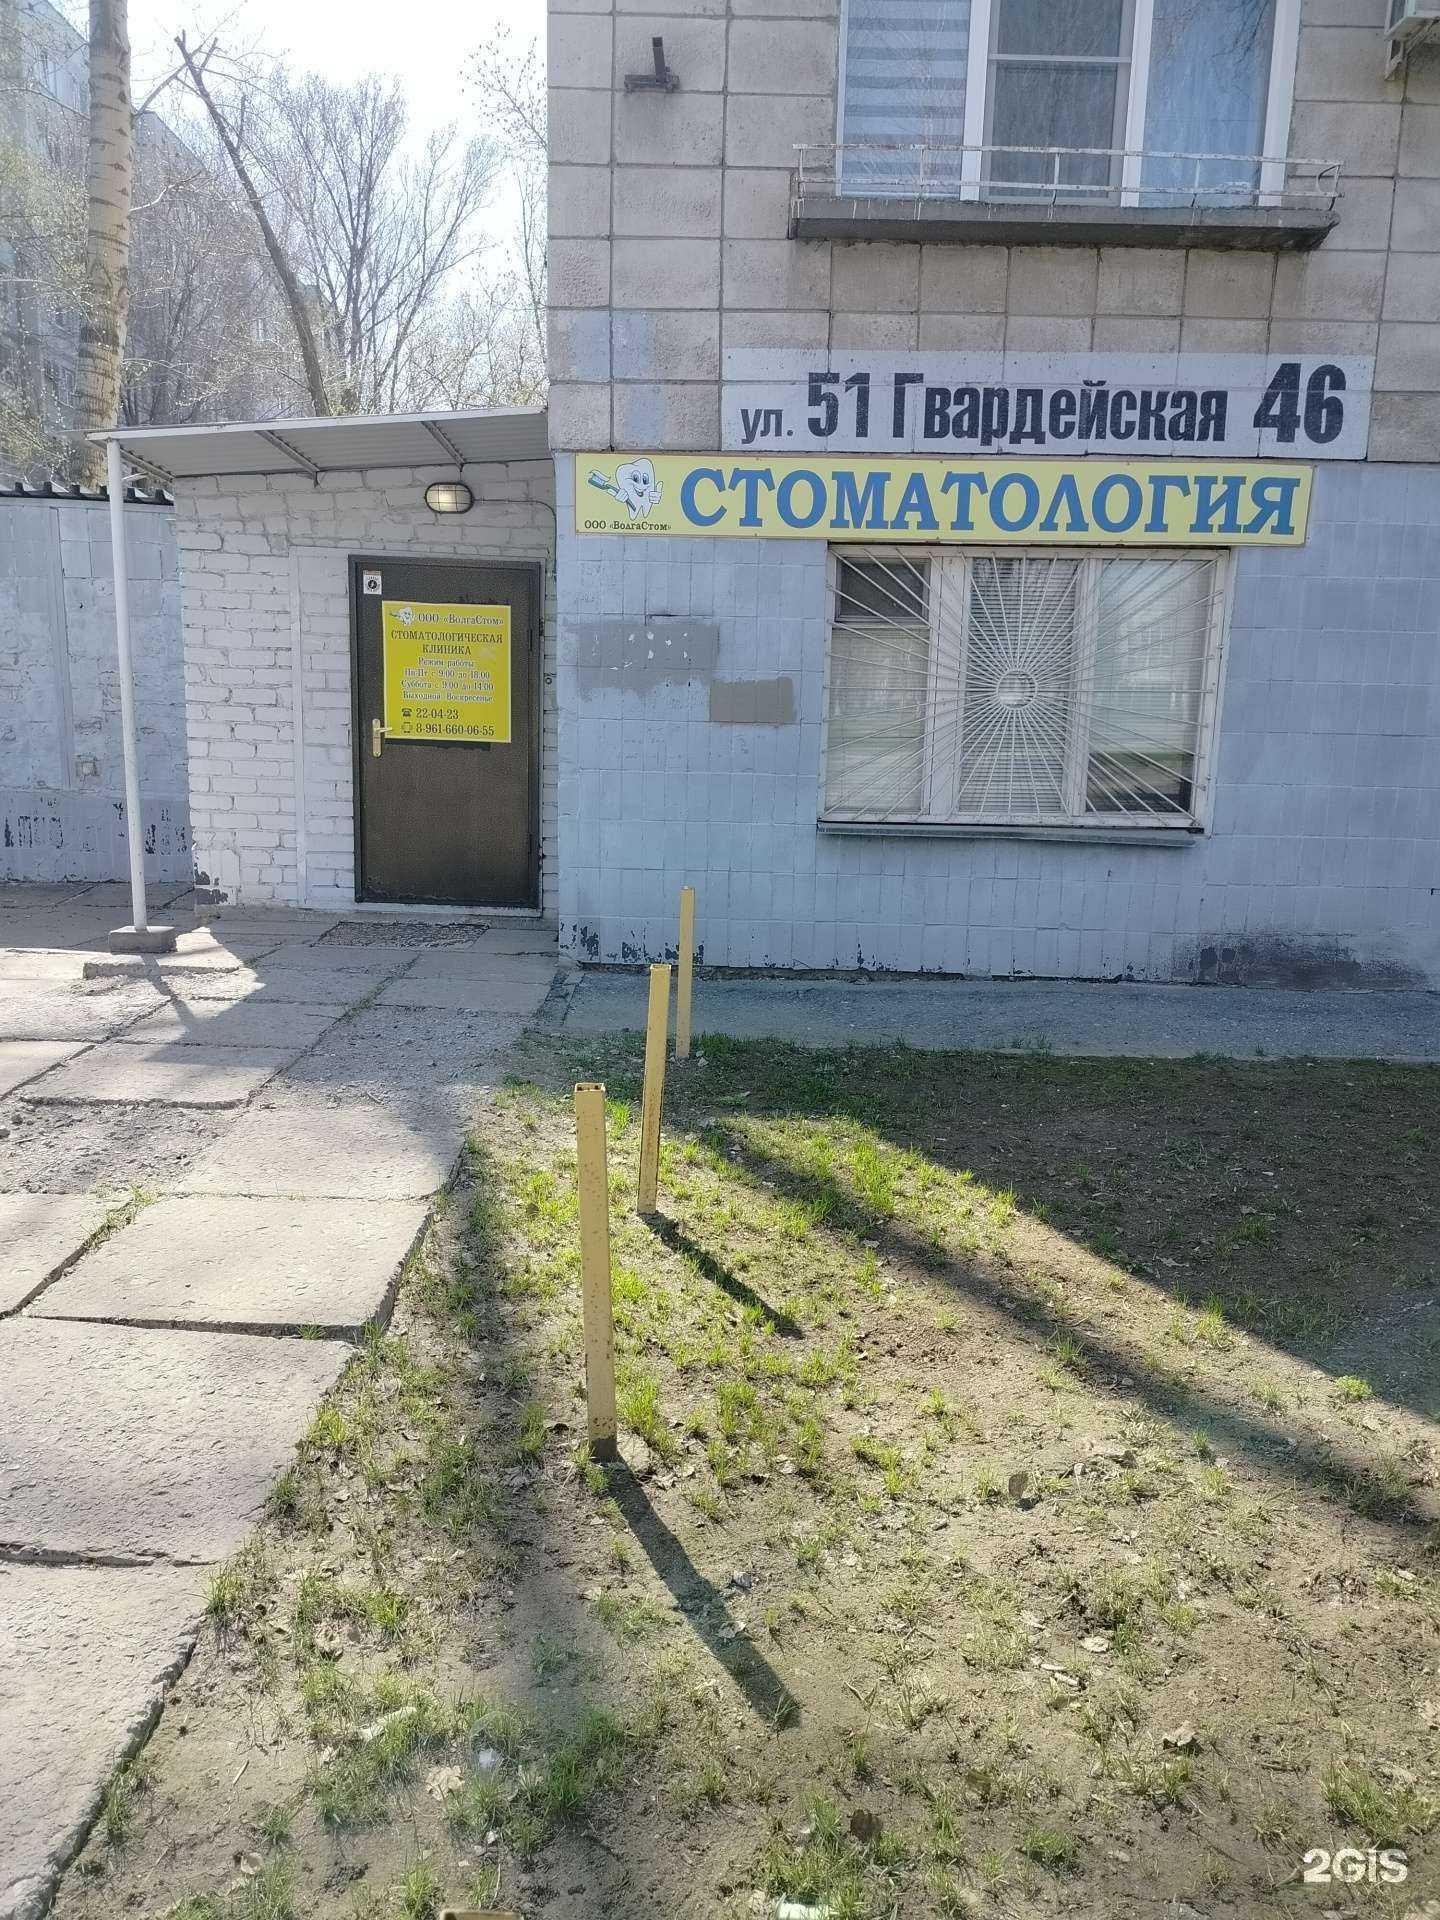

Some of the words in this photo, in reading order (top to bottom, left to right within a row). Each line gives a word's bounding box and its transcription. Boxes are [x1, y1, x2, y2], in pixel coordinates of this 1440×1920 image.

[741, 408, 794, 444] ул.
[807, 372, 870, 438] 51
[892, 372, 1228, 447] Гвардейская
[1253, 363, 1347, 444] 46
[680, 467, 1301, 536] СТОМАТОЛОГИЯ
[584, 519, 607, 530] ООО
[610, 520, 672, 531] «ВолгаСтом»
[418, 613, 440, 623] ООО
[444, 613, 504, 625] «ВолгаСтом»
[391, 630, 503, 643] СТОМАТОЛОГИЧЕСКАЯ
[422, 644, 472, 656] КЛИНИКА
[416, 707, 460, 720] 22-04-23
[416, 723, 495, 737] 8-961-660-06-55
